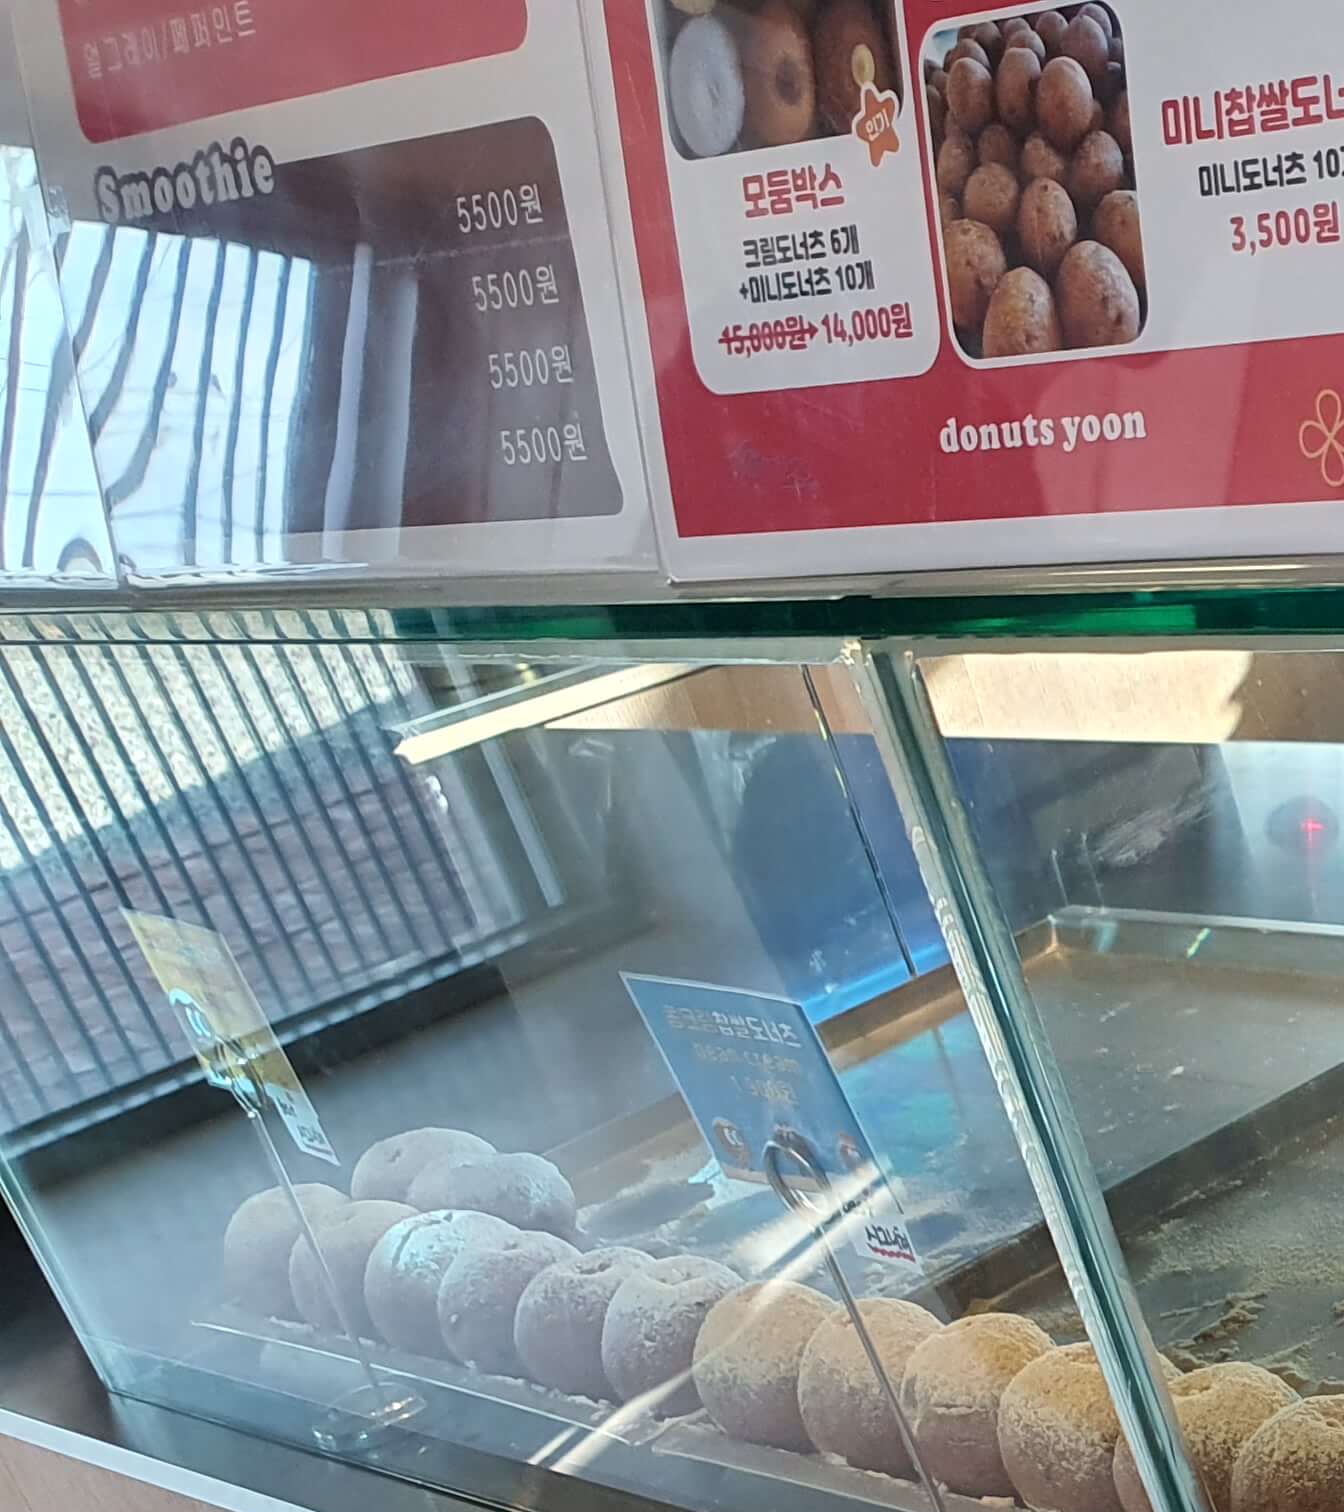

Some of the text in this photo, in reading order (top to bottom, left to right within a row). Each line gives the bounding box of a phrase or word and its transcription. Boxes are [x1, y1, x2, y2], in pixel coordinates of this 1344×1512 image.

[864, 108, 890, 139] 인기
[96, 138, 275, 224] Smoothie
[742, 162, 845, 218] 모둠박스
[1198, 151, 1308, 197] 미니도너츠
[456, 184, 544, 233] 5500원
[1230, 200, 1341, 256] 3,500원
[743, 224, 860, 268] 크림도너츠 6개
[471, 264, 559, 312] 5500원
[835, 260, 875, 291] 10개
[821, 302, 913, 347] 14,000원
[488, 344, 574, 389] 5500원
[500, 422, 588, 465] 5500원
[939, 410, 1147, 453] donuts yoon
